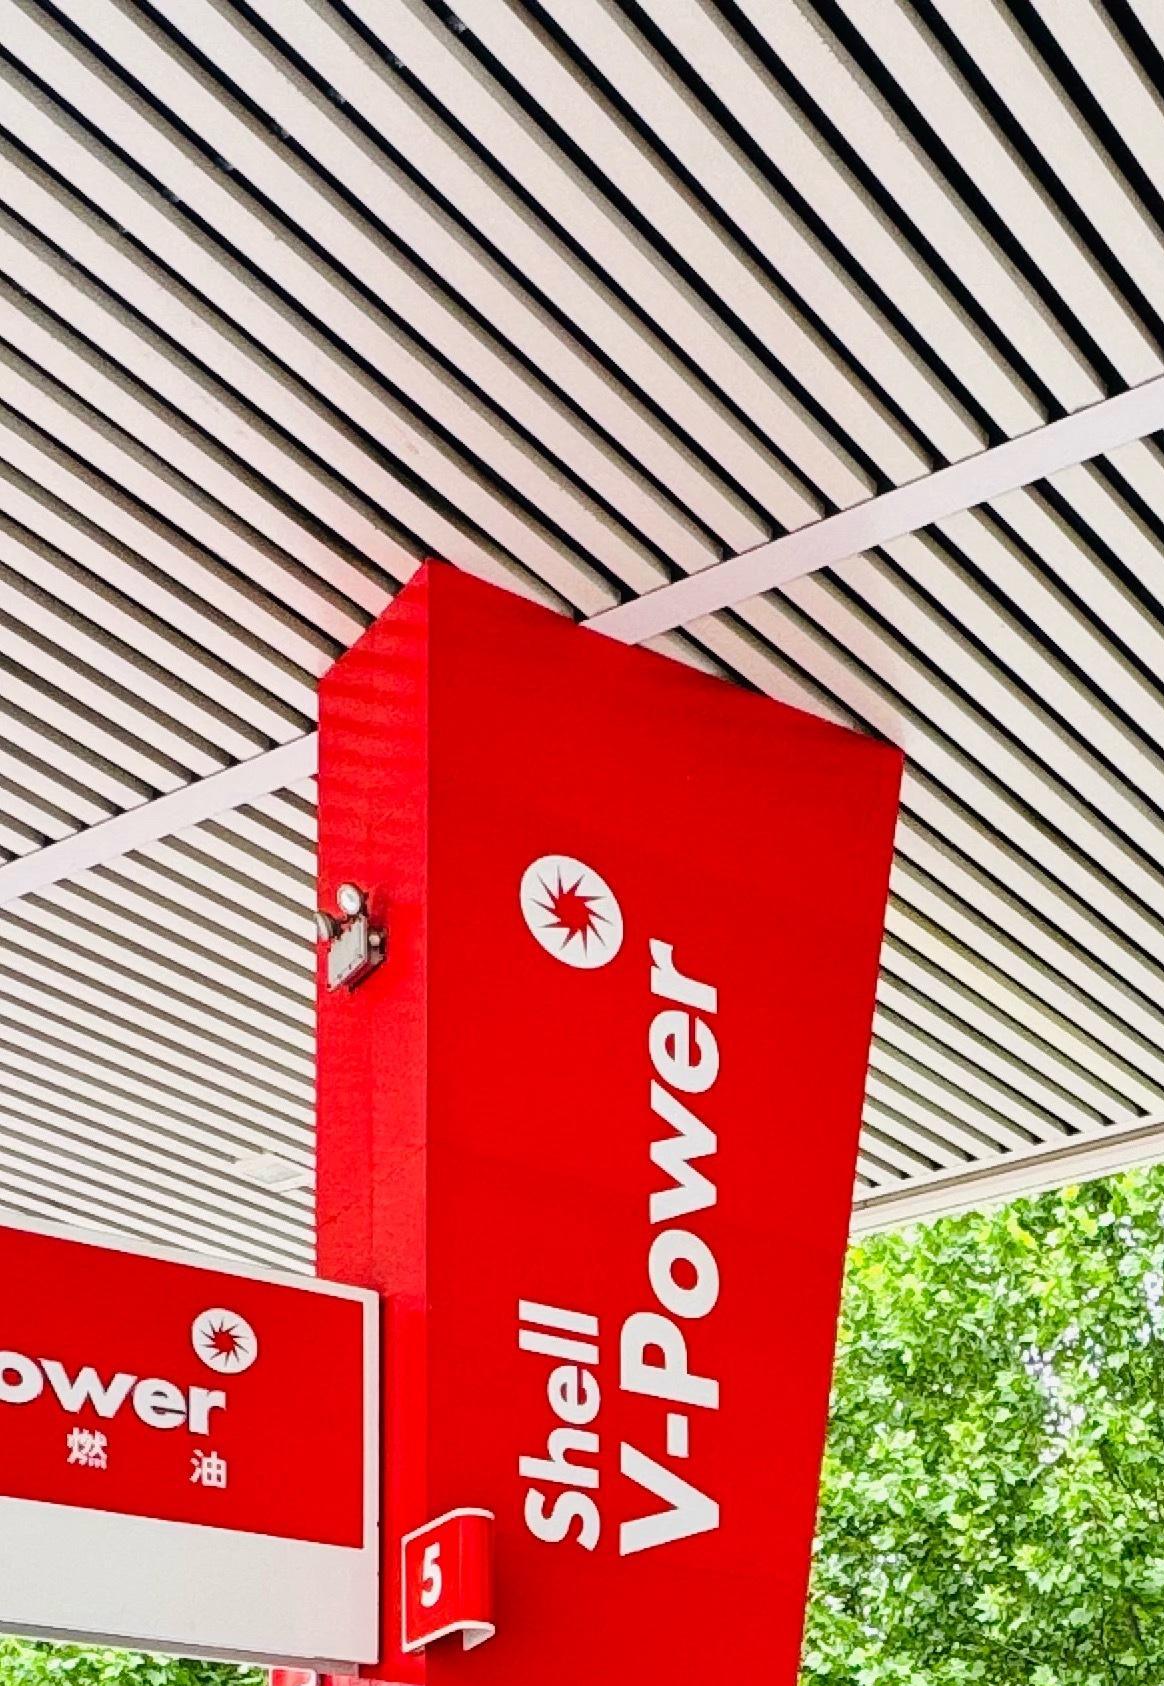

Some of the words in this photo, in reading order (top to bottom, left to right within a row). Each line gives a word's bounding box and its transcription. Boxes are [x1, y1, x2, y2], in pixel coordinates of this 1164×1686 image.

[618, 937, 720, 1557] V-Power
[518, 1298, 601, 1552] Shell
[419, 1540, 443, 1609] 5
